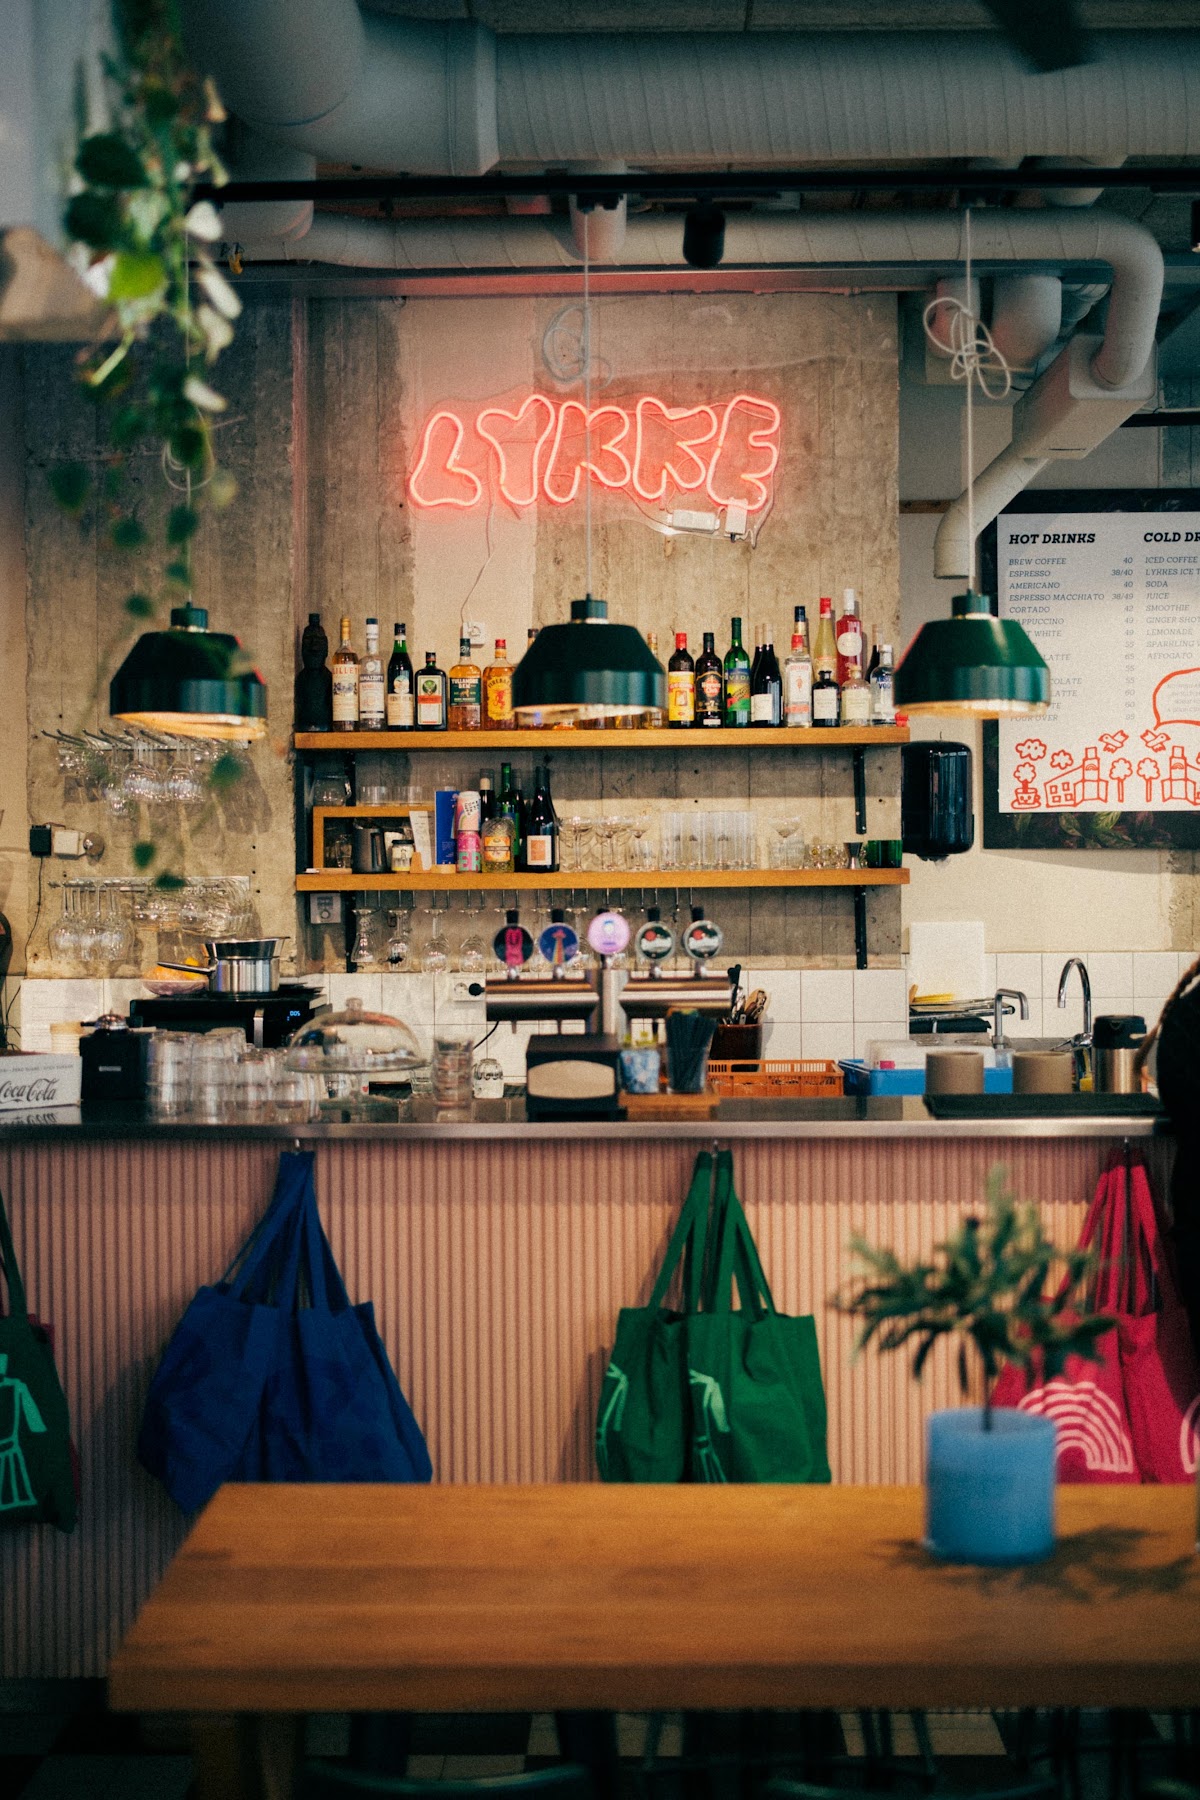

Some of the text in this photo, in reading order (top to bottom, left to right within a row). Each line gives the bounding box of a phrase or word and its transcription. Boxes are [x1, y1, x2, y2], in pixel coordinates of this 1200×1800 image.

[409, 394, 781, 511] LYKKE
[1009, 533, 1096, 544] HOT DRINKS
[1143, 532, 1182, 543] COLD
[1009, 558, 1033, 566] BREW
[1034, 557, 1067, 566] COFFEE
[1145, 556, 1198, 564] ICED COFFEE
[1009, 569, 1134, 578] ESPRESSO 38/40
[1180, 568, 1194, 576] ICE
[1009, 581, 1061, 590] AMERICANO
[1145, 580, 1169, 588] SODA
[1009, 594, 1051, 602] ESPRESSO
[1052, 593, 1105, 601] MACCHIATO
[1145, 592, 1170, 600] JUICE
[1009, 606, 1051, 614] CORTADO
[1145, 604, 1190, 612] SMOOTHIE
[1145, 616, 1177, 624] GINGER
[1146, 628, 1193, 636] LEMONADE
[1146, 640, 1195, 648] SPARKLING
[1147, 652, 1193, 660] AFFOGATO
